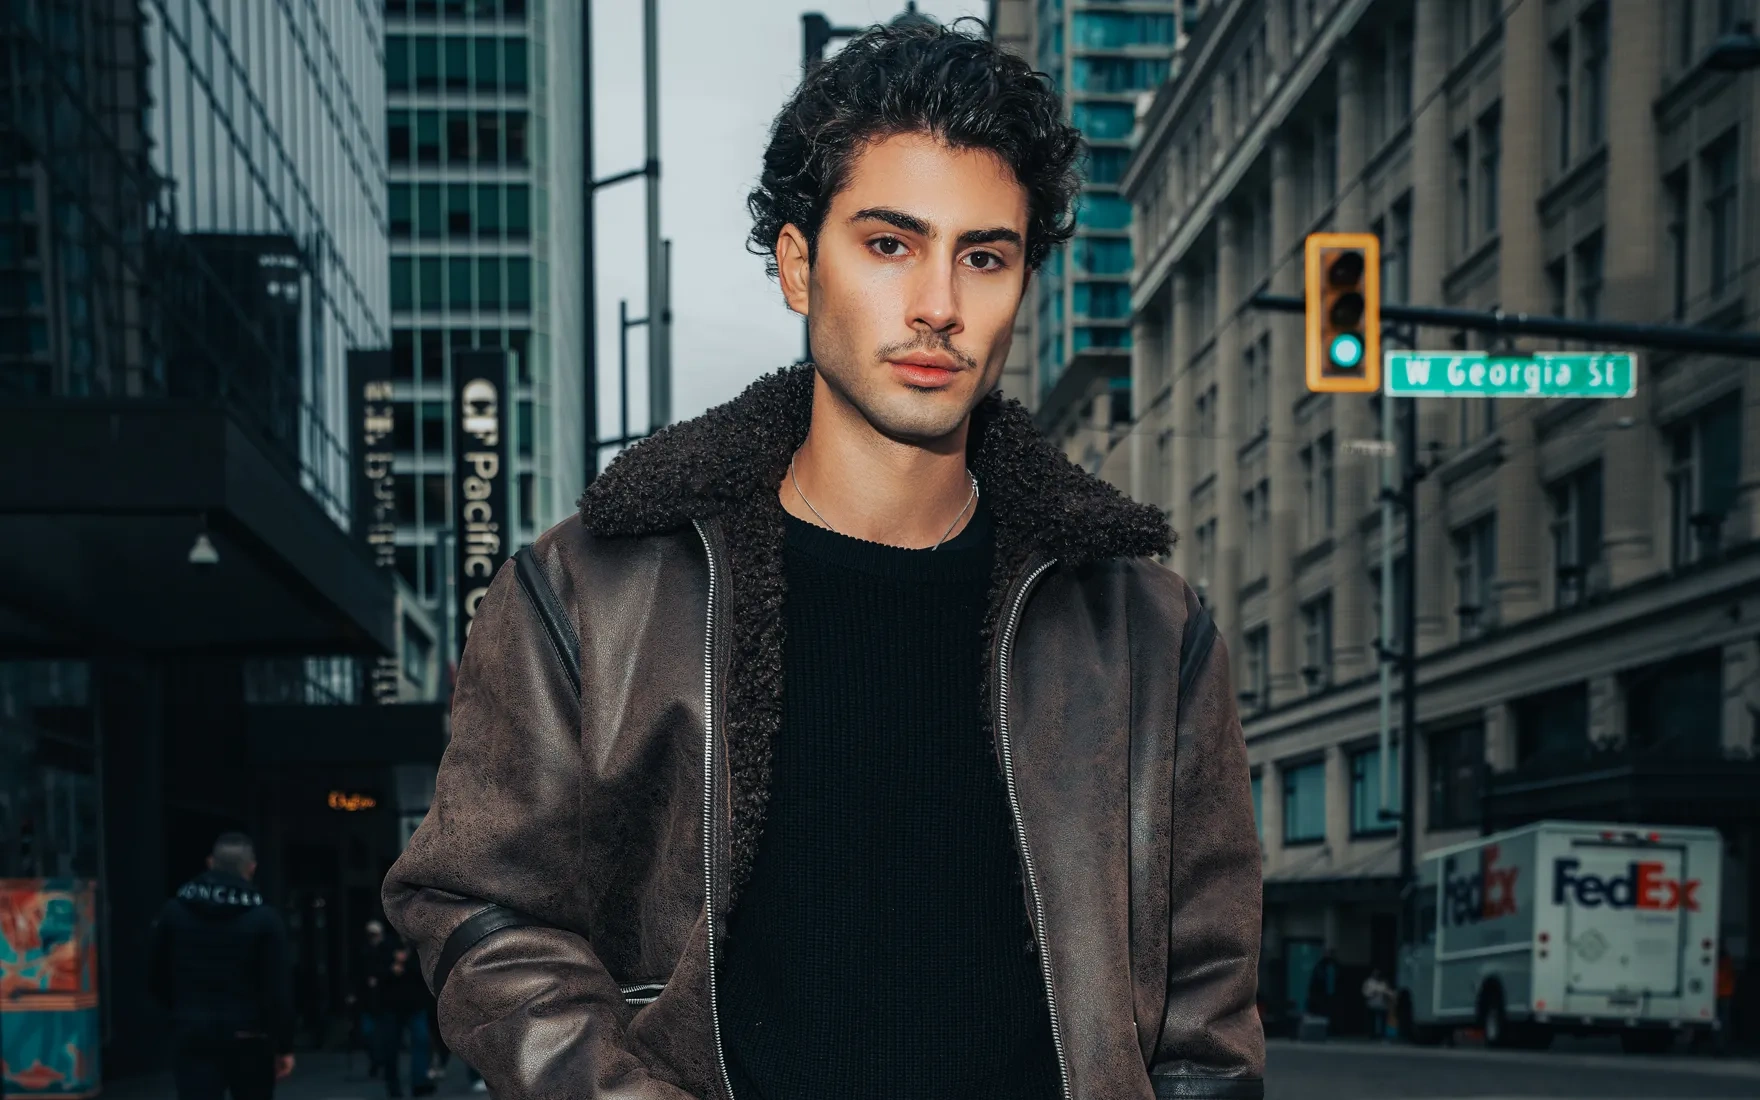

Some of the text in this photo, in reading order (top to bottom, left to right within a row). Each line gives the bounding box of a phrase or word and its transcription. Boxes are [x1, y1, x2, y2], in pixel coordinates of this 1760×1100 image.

[1405, 358, 1616, 394] W Georgia St
[462, 379, 499, 446] CF
[463, 452, 500, 578] Pacific
[1553, 857, 1701, 912] FedEx
